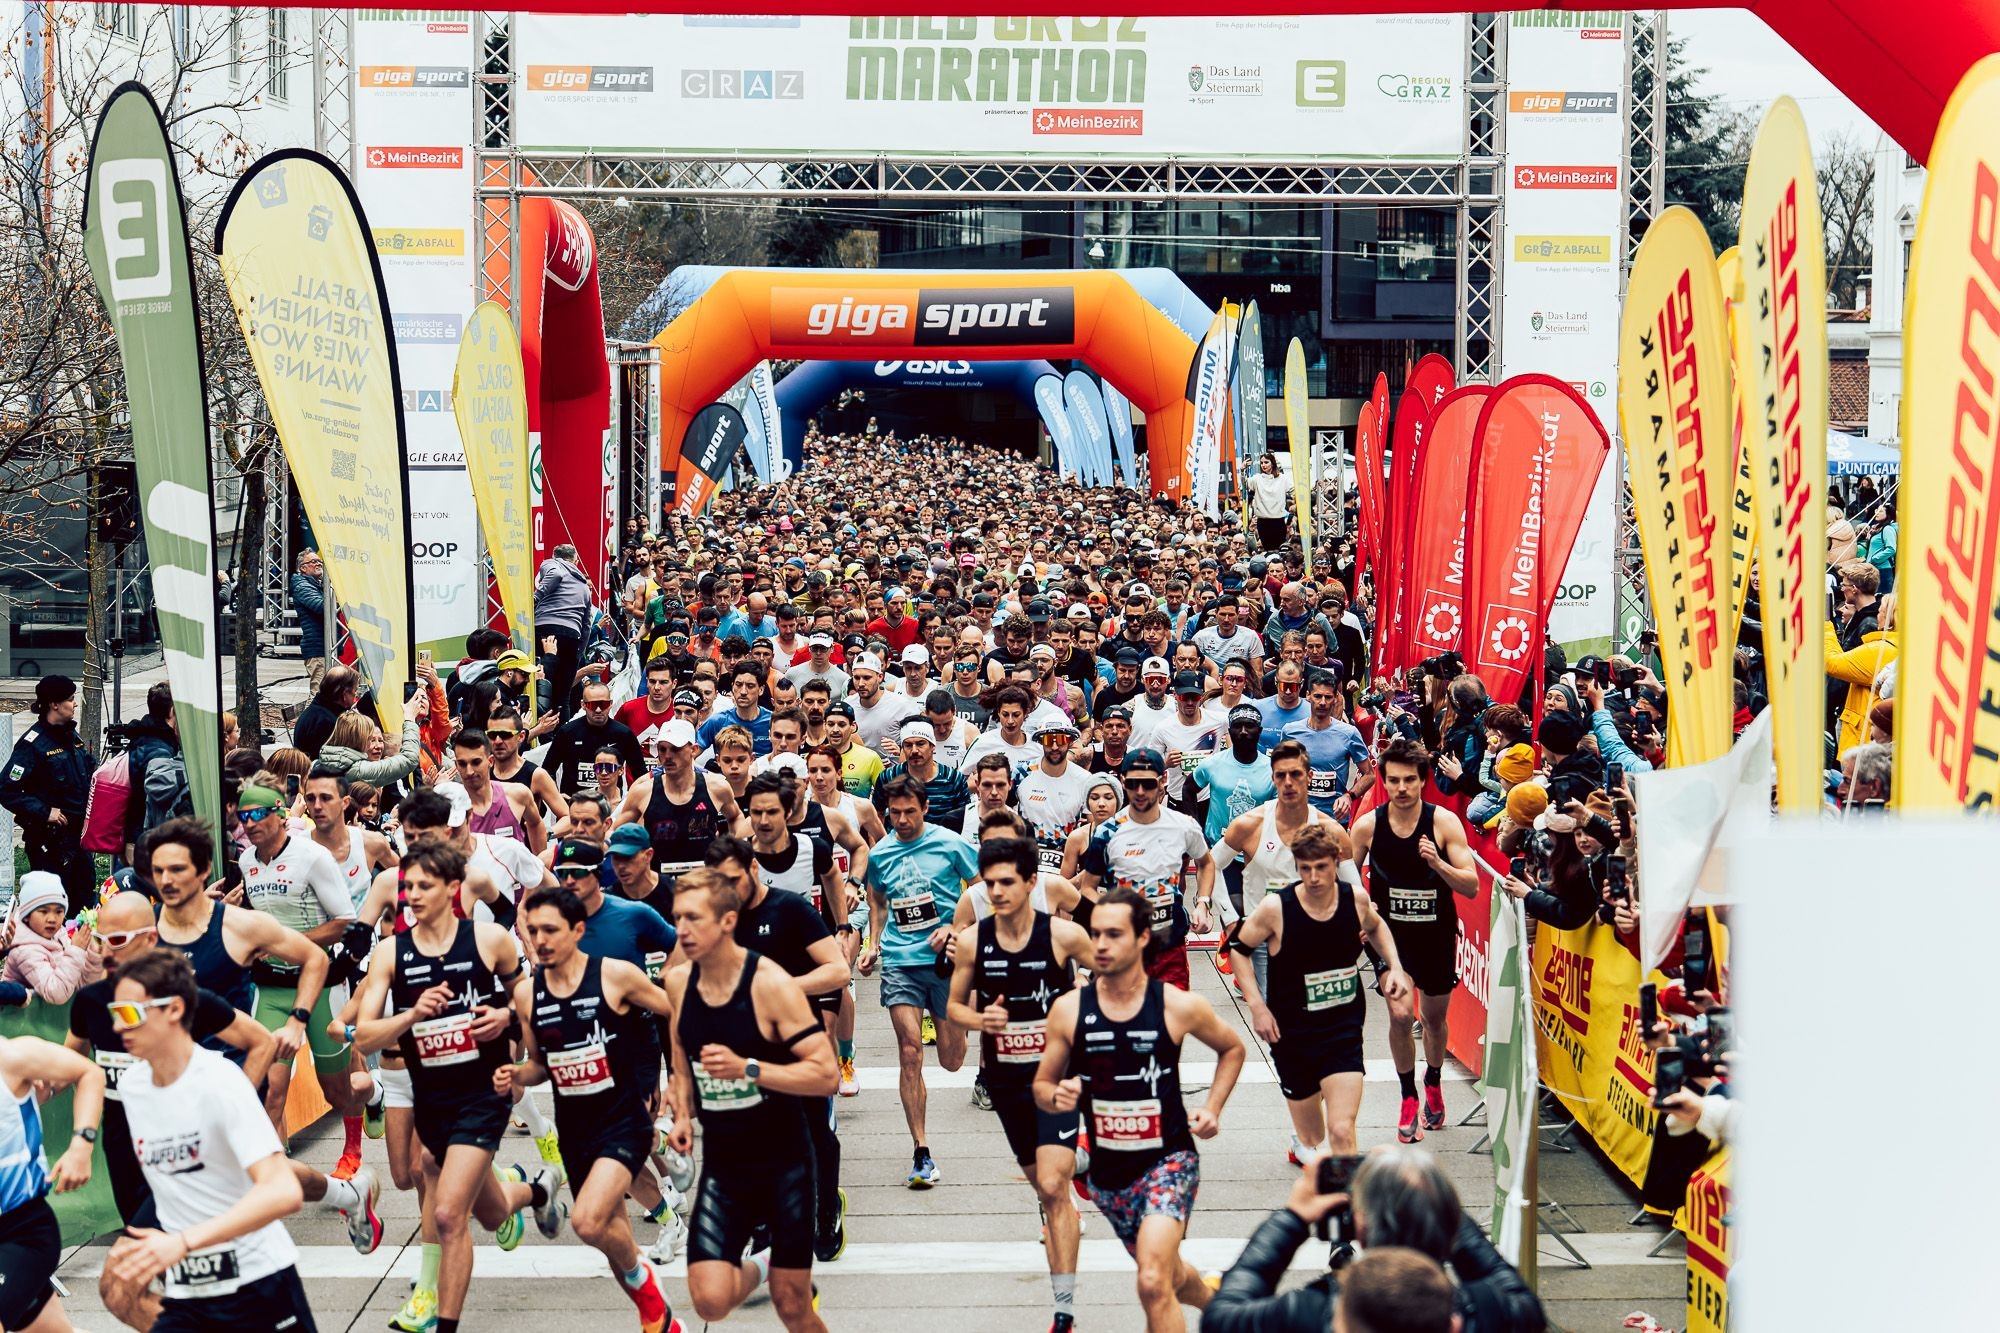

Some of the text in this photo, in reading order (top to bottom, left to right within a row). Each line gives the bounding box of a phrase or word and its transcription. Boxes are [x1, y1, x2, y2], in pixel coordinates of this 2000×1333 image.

[373, 69, 465, 86] giga sport
[543, 69, 649, 88] giga sport
[847, 47, 1148, 103] MARATHON
[1210, 66, 1261, 78] Das Land
[684, 74, 798, 98] GRAZ
[1411, 77, 1451, 85] REGION
[1206, 82, 1261, 94] Steiermark
[1397, 85, 1451, 98] GRAZ
[1523, 95, 1614, 111] giga sport
[1057, 115, 1139, 130] MeinBezirk
[387, 151, 460, 164] MeinBezirk
[1538, 171, 1614, 184] MeinBezirk
[415, 238, 456, 248] ABFALL
[1563, 244, 1602, 255] ABFALL
[1270, 283, 1291, 293] hba
[807, 296, 1050, 336] giga sport
[1547, 311, 1588, 321] Das Land
[1545, 323, 1588, 333] Steiermark
[700, 414, 731, 472] sport
[433, 452, 465, 463] GRAZ
[1396, 899, 1429, 910] 1128
[905, 906, 922, 919] 56
[1315, 979, 1352, 996] 2418
[423, 1030, 466, 1051] 3076
[1004, 1033, 1046, 1049] 3093
[558, 1061, 599, 1081] 3078
[1103, 1115, 1151, 1133] 3089
